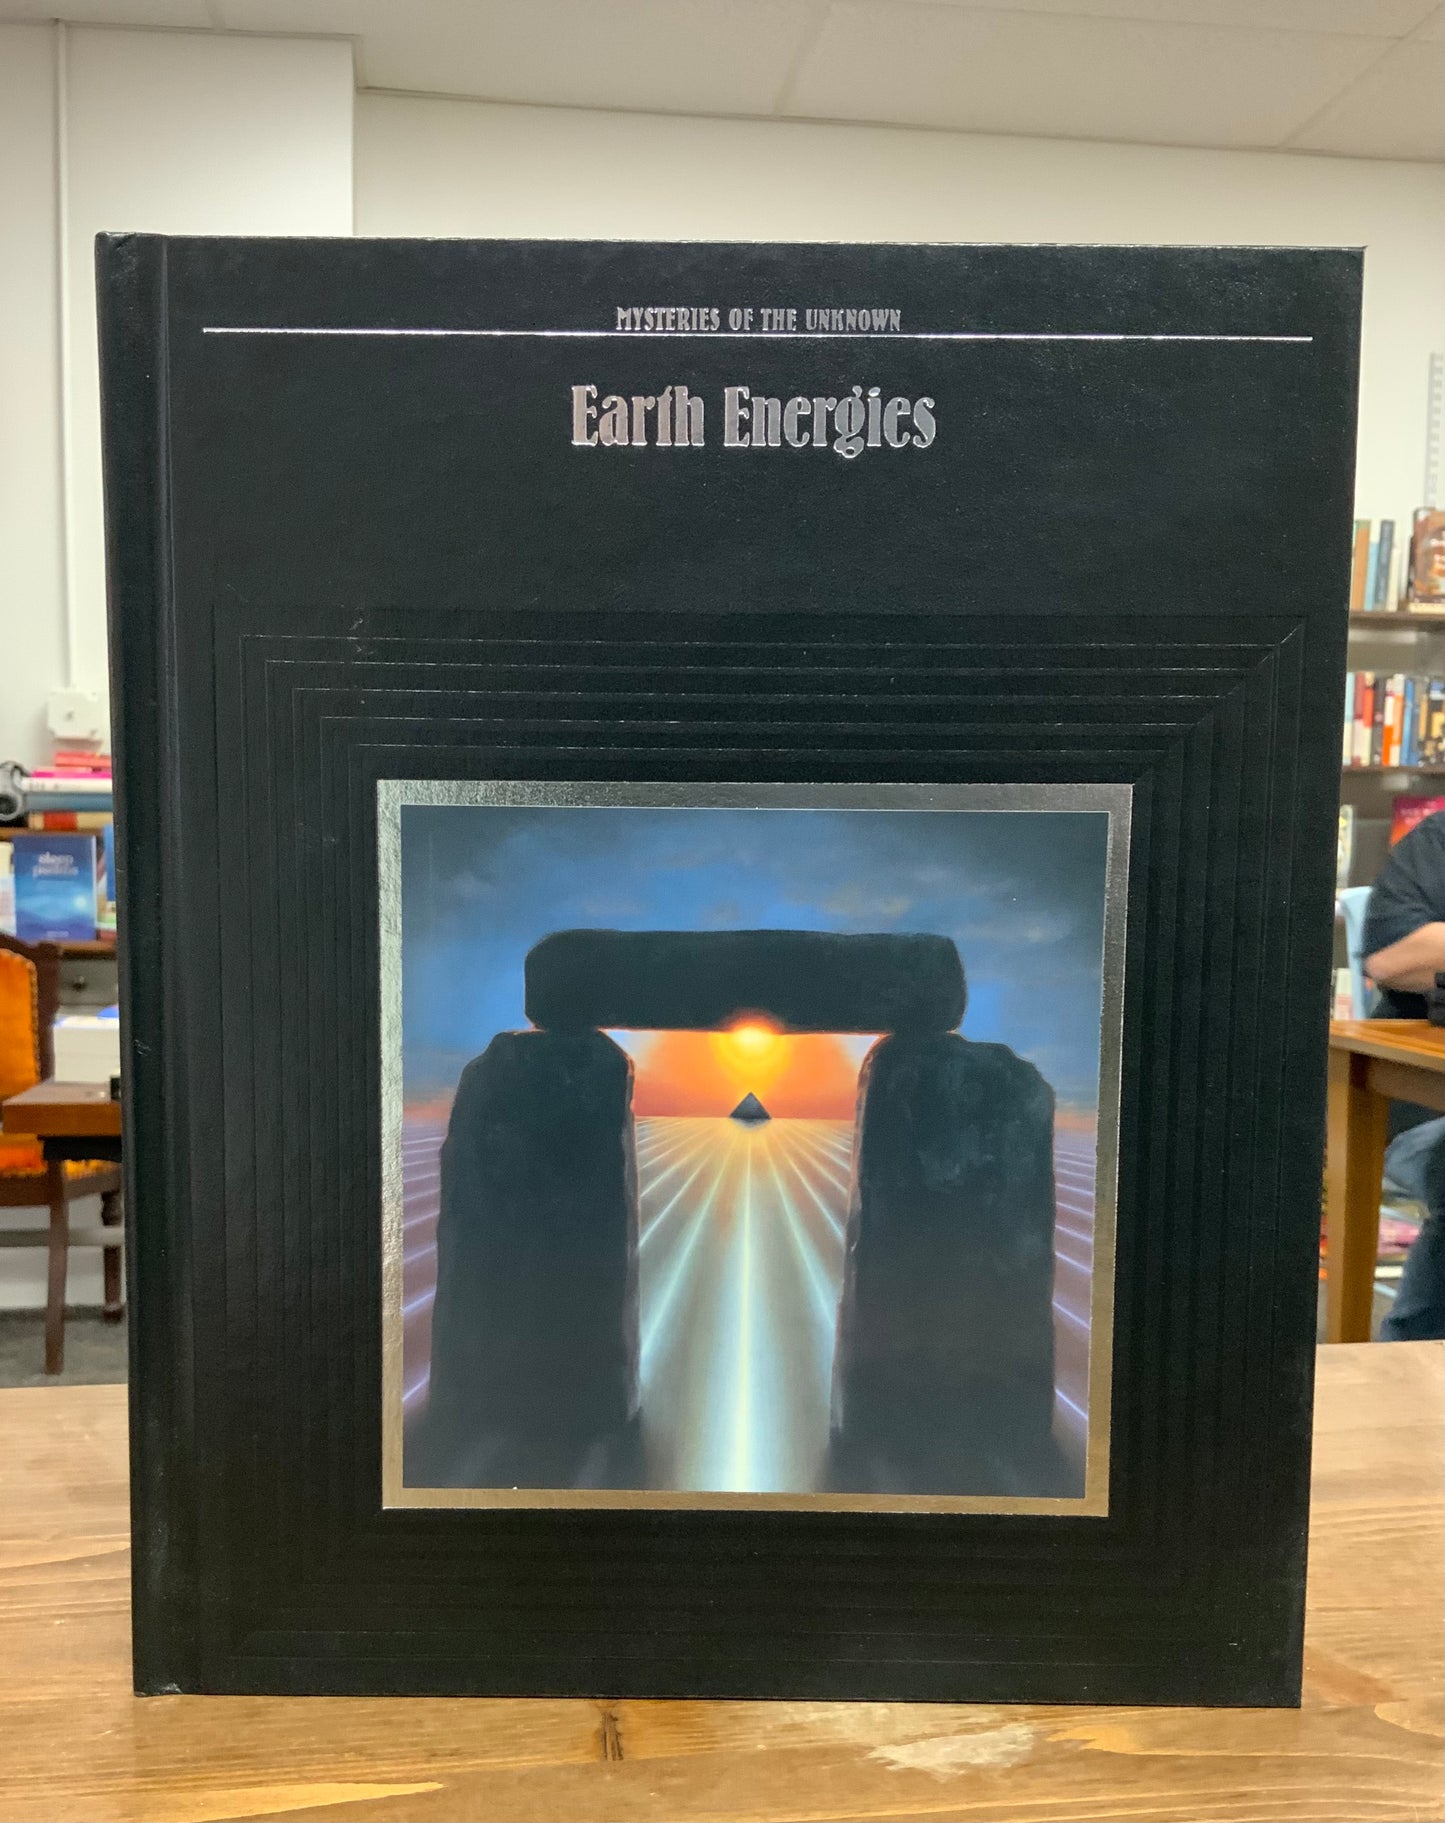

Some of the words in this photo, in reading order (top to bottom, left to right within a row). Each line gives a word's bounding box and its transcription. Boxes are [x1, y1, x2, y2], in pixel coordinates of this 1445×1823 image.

[616, 307, 720, 332] MYSTERIES
[728, 308, 754, 332] OF
[761, 308, 797, 332] THE
[806, 309, 901, 332] UNKNOWN
[571, 385, 705, 447] Earth
[724, 386, 936, 459] Energies
